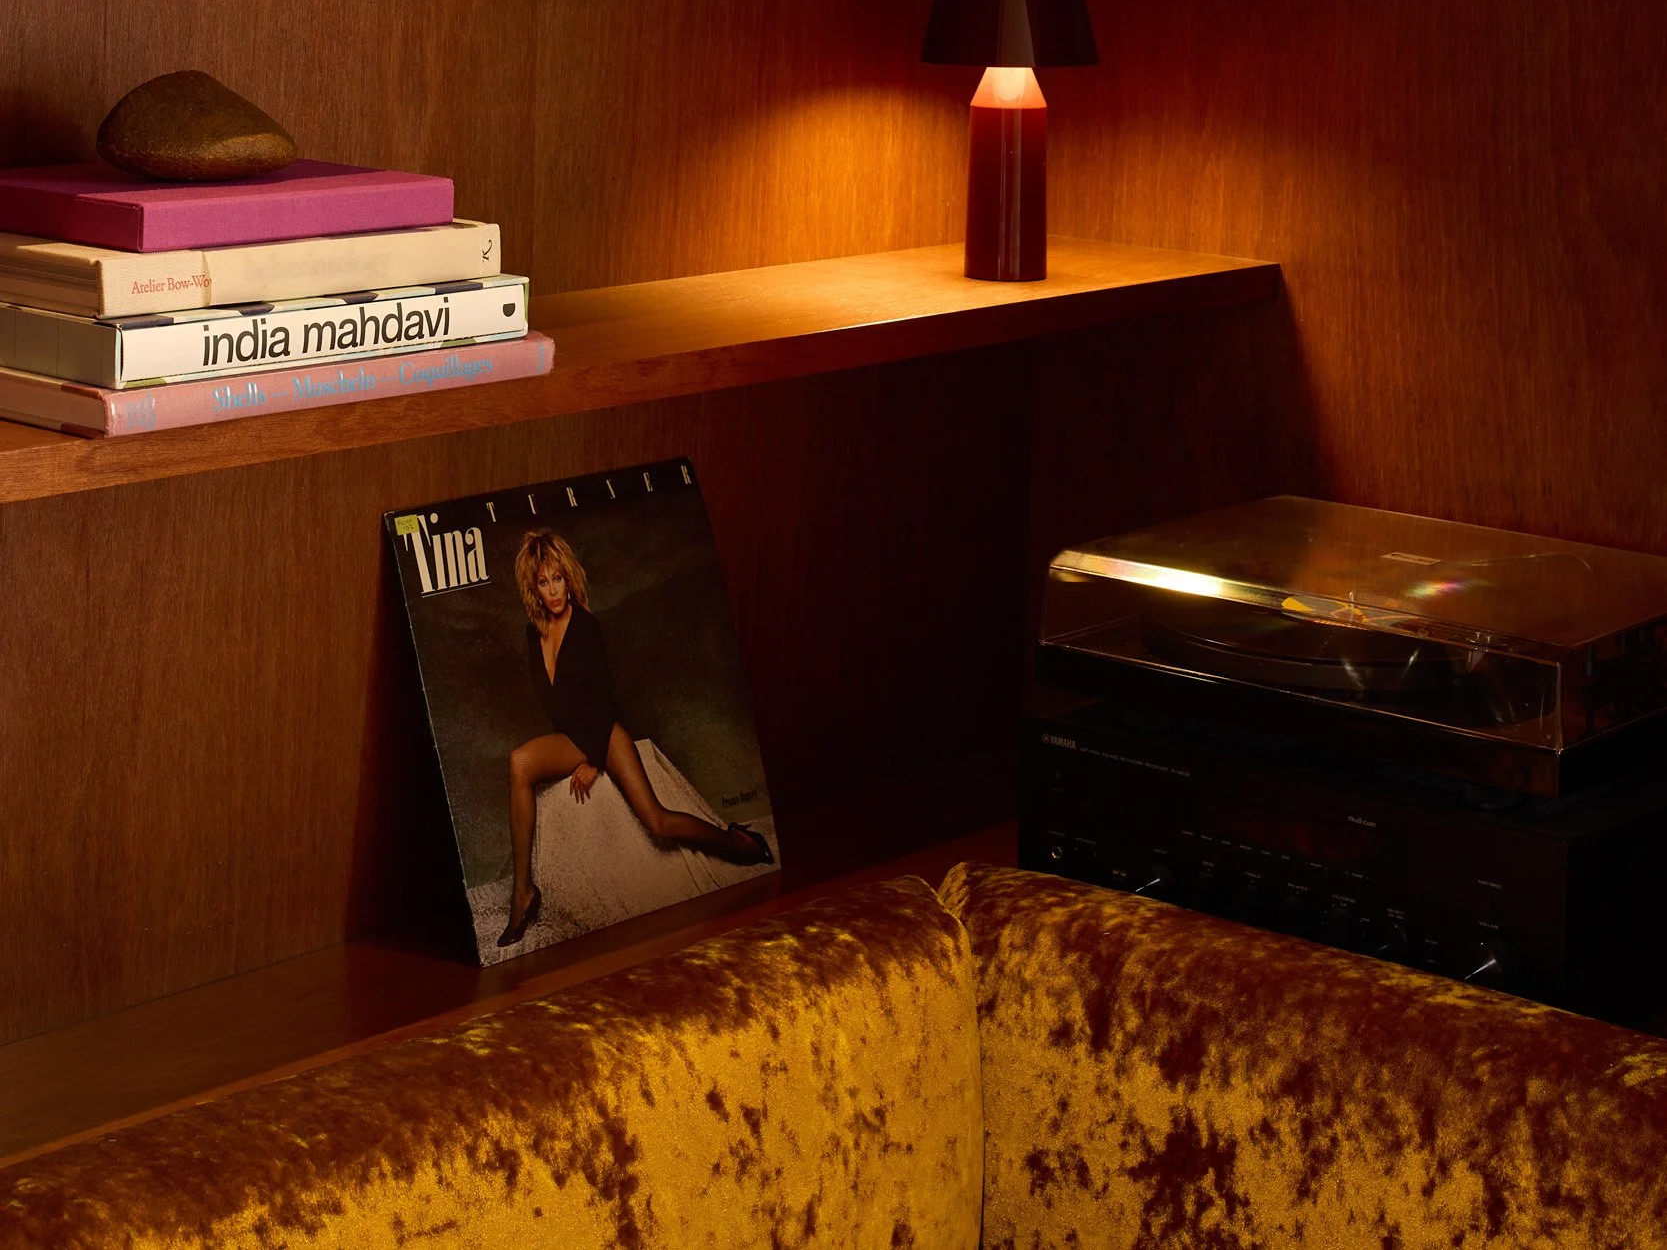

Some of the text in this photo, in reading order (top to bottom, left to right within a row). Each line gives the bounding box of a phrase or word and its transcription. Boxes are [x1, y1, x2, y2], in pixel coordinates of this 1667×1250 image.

[131, 280, 166, 295] Atelier
[202, 296, 450, 366] india mahdavi
[212, 355, 493, 412] Shells Muscheln Coquillages
[402, 512, 490, 594] Tina
[1050, 734, 1077, 750] YAMAHA
